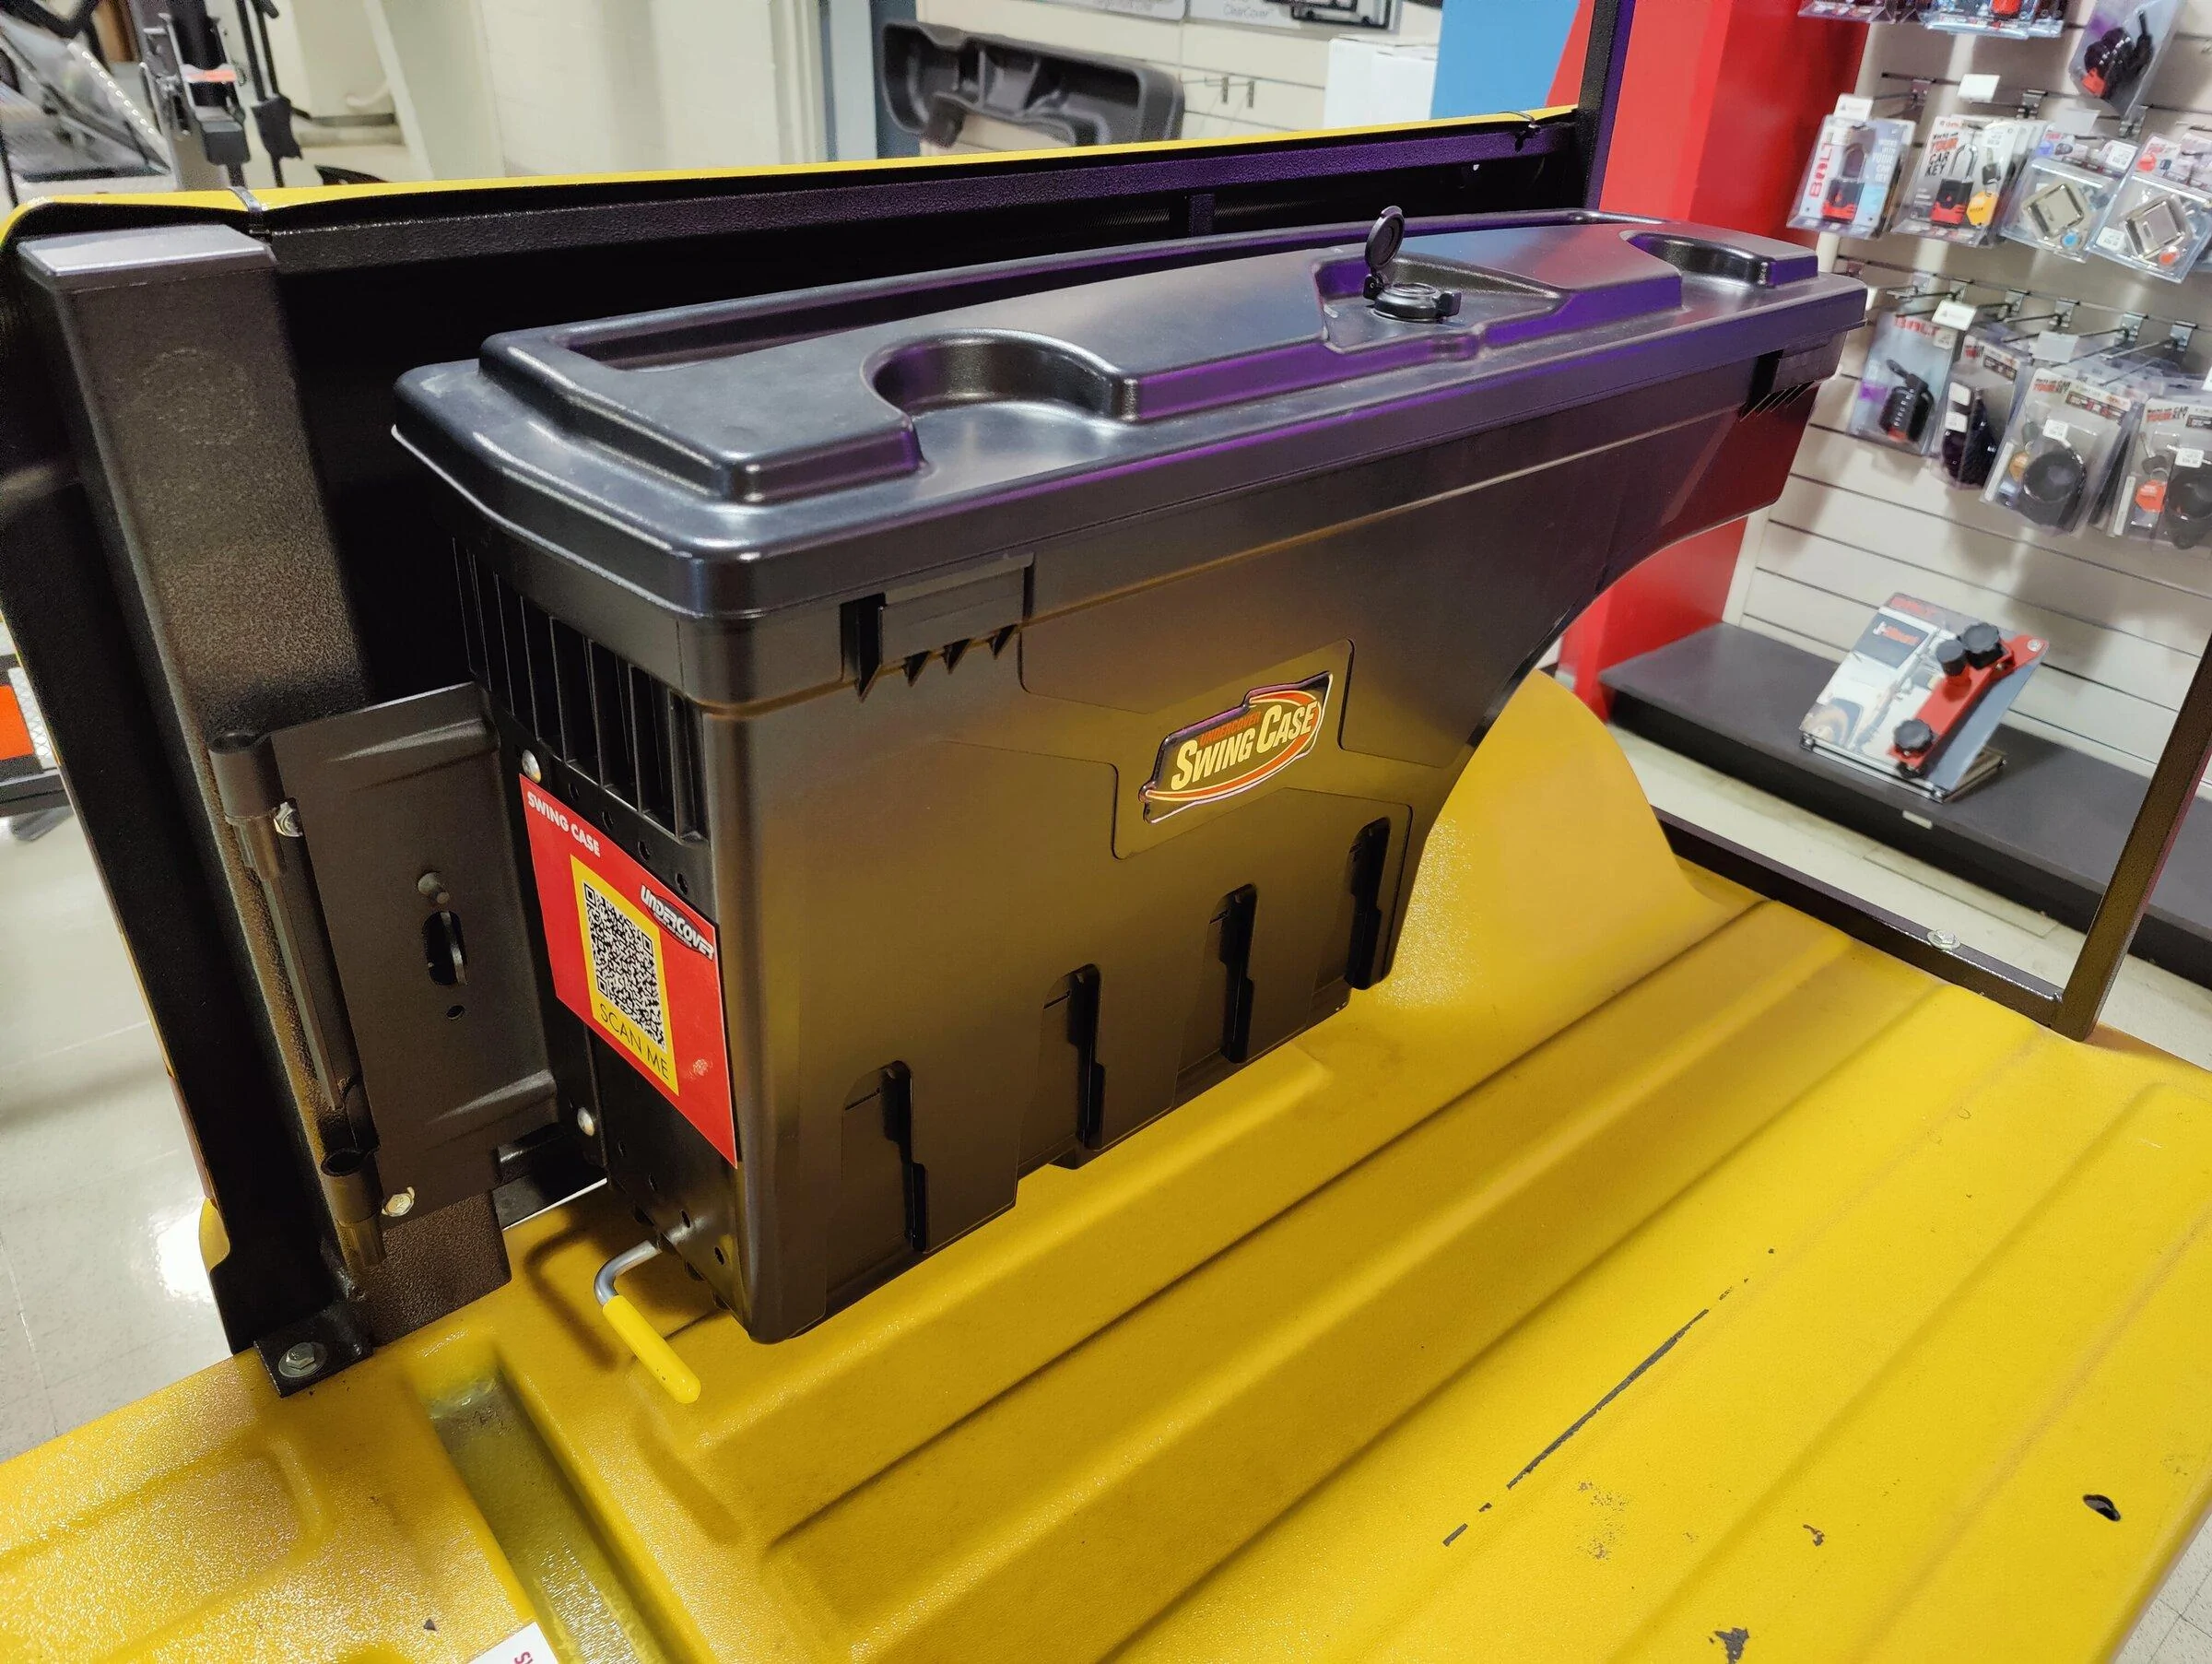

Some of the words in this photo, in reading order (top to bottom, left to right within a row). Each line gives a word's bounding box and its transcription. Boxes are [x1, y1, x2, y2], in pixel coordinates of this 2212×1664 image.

[1925, 163, 1947, 177] KEY
[1929, 151, 1950, 165] CAR
[1171, 738, 1256, 791] SWING
[1256, 701, 1320, 754] CASE
[1199, 711, 1262, 747] UNDERCOVER
[527, 790, 571, 833] SWING
[571, 821, 602, 858] CASE
[641, 884, 714, 961] UNDERCOVER
[599, 1003, 643, 1056] SCAN
[646, 1045, 671, 1080] ME
